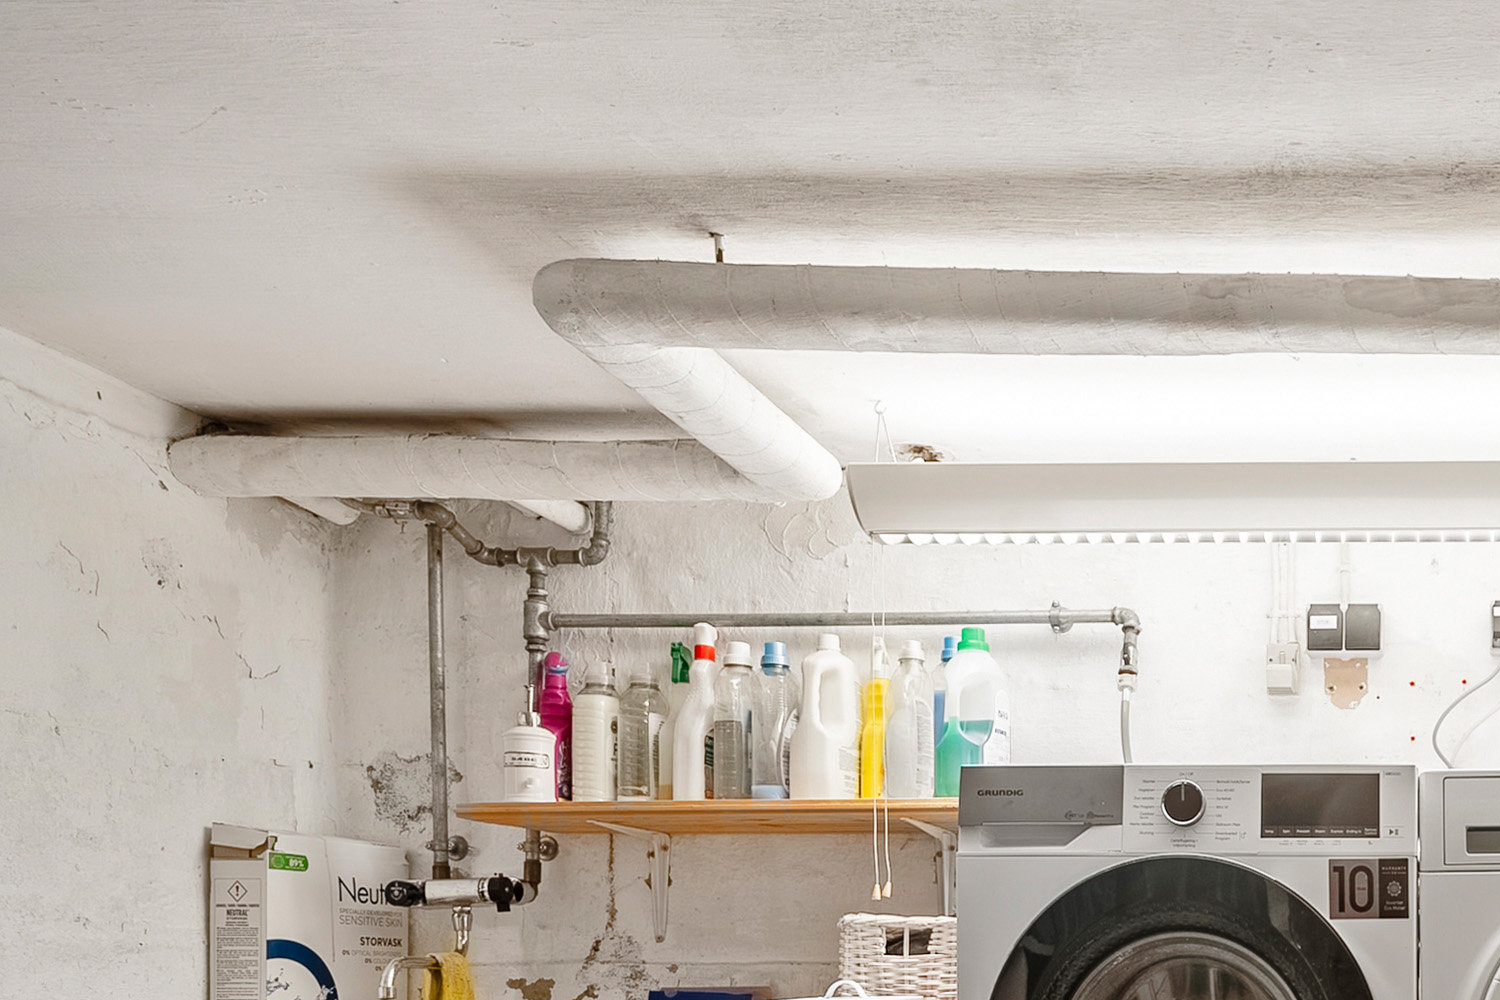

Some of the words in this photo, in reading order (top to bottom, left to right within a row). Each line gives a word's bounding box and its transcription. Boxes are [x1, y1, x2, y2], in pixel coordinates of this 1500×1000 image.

[987, 789, 1024, 797] GRUNDIG
[338, 876, 388, 906] Neut
[1332, 865, 1374, 913] 10
[339, 915, 385, 928] SENSITIVE
[386, 917, 403, 928] SKIN
[360, 936, 403, 948] STORVASK
